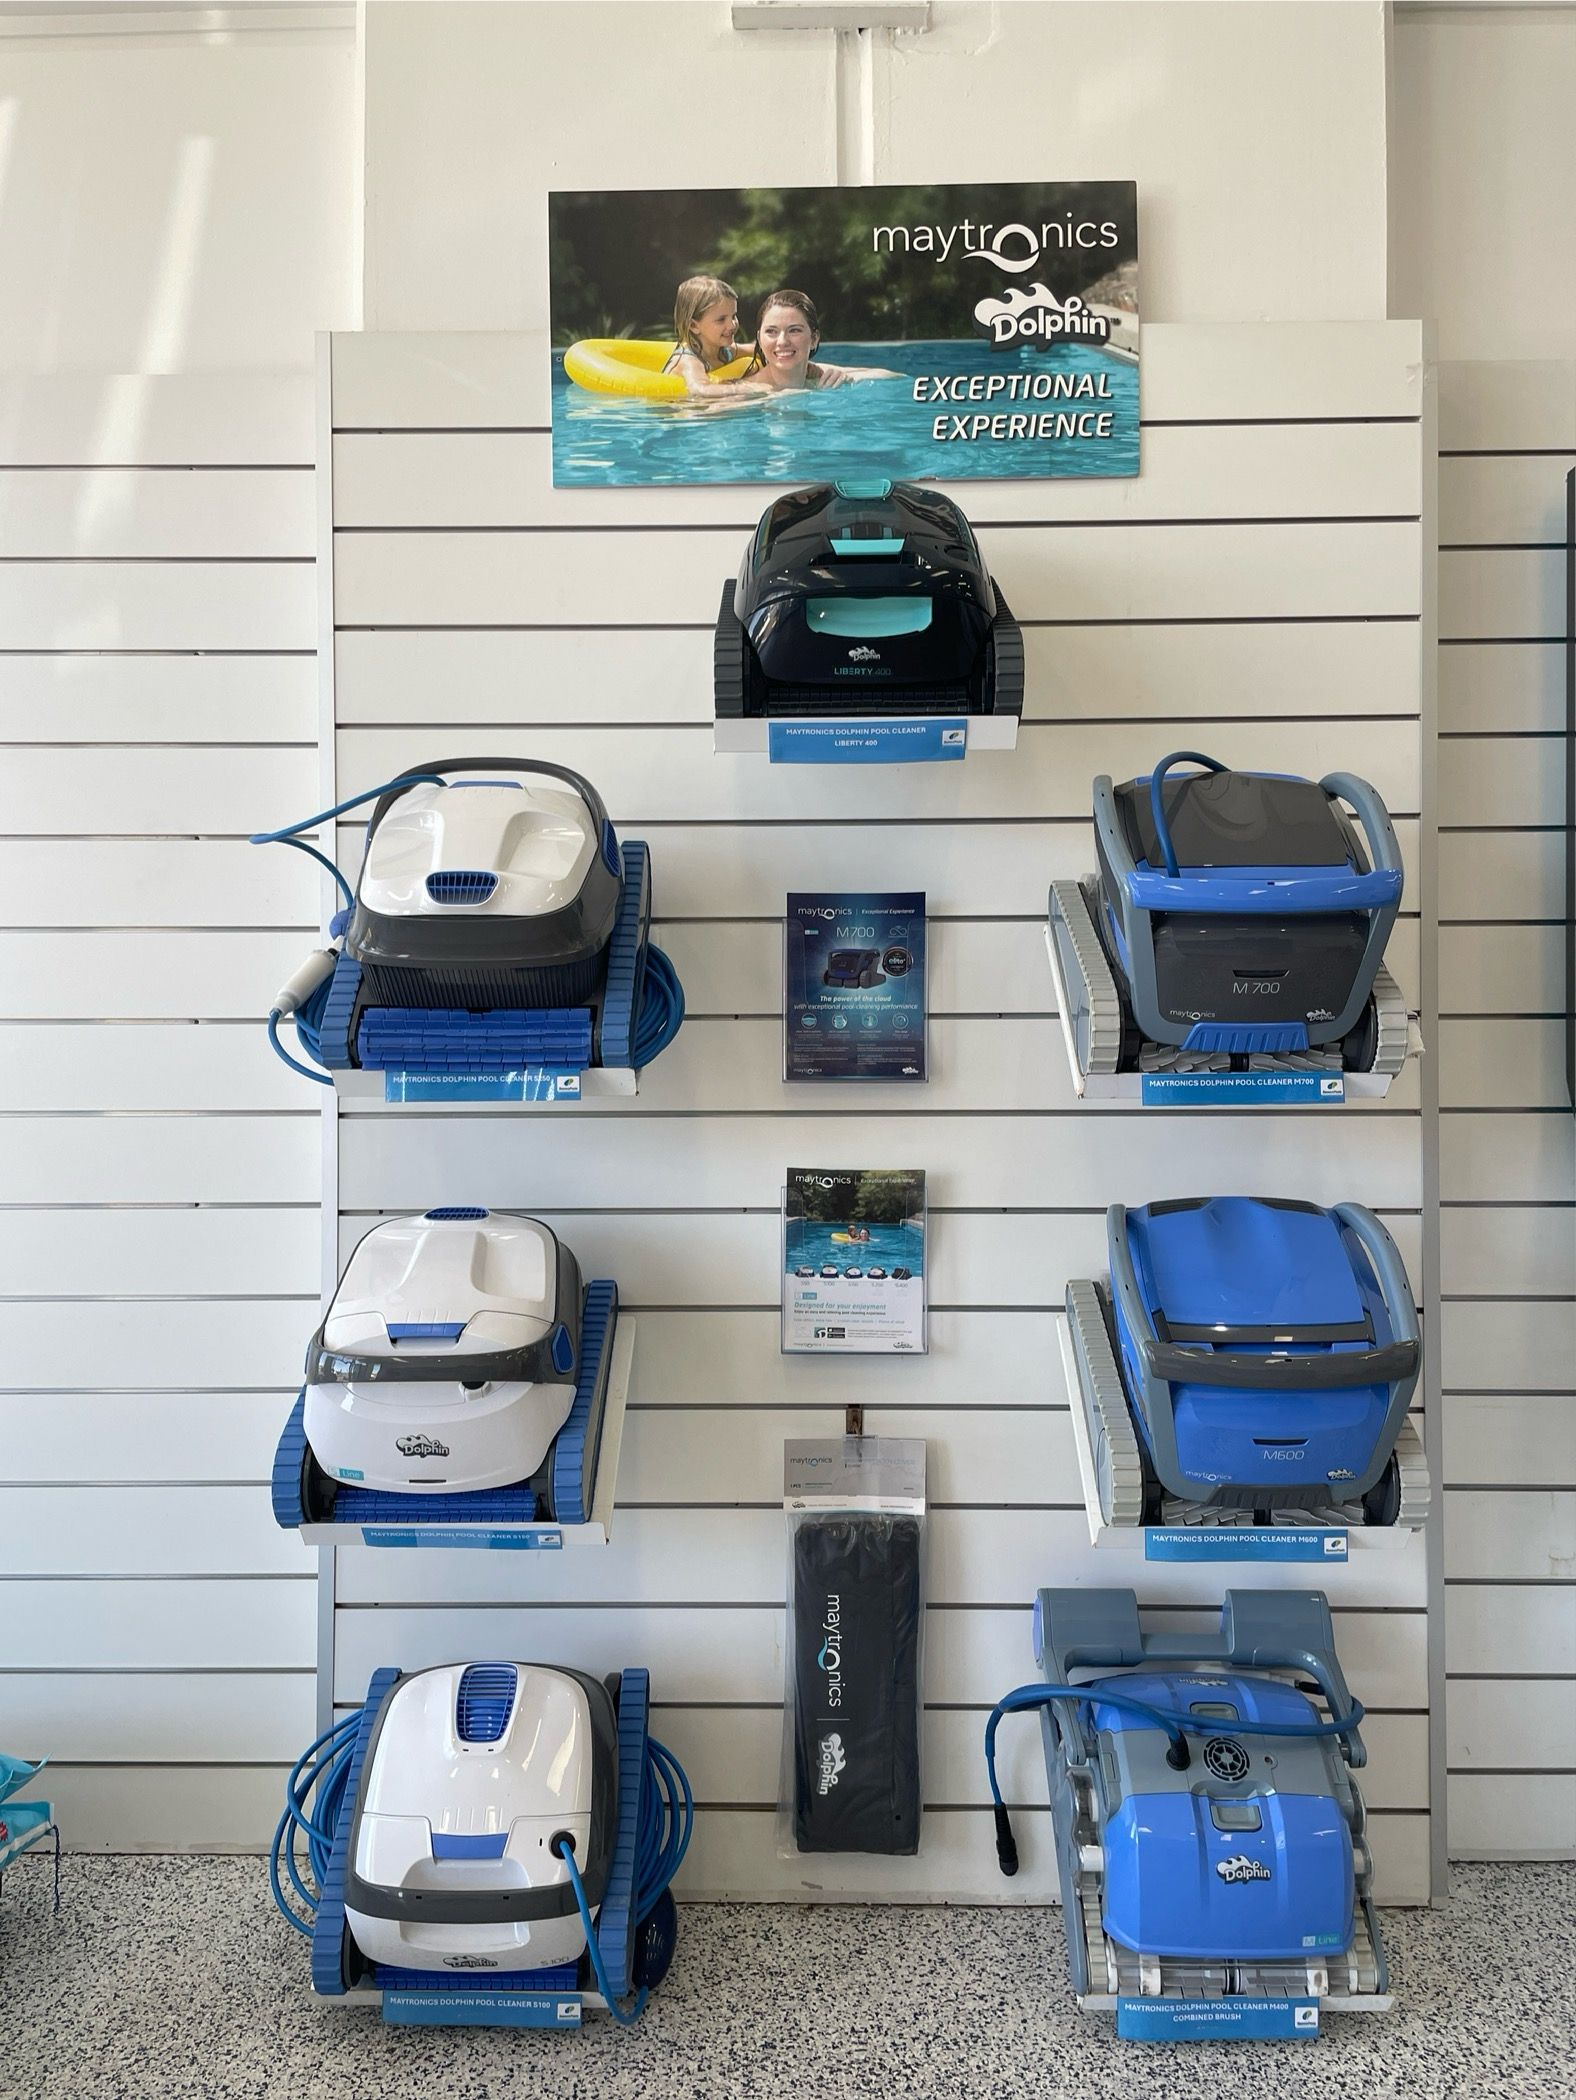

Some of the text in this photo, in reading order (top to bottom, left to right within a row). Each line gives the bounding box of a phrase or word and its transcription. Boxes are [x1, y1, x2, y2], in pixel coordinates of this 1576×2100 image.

[873, 212, 1119, 273] maytronics
[986, 293, 1107, 343] Dolphin
[912, 373, 1113, 401] EXCEPTIONAL
[932, 412, 1114, 440] EXPERIENCE
[852, 648, 881, 661] Dolphin
[834, 667, 873, 675] LIBERTY
[797, 907, 852, 920] maytronics
[808, 1003, 840, 1011] exceptional
[841, 1003, 855, 1011] pool
[856, 1003, 880, 1011] cleaning
[1169, 1009, 1216, 1021] maytronics
[1308, 1010, 1336, 1022] Dolphin
[393, 1075, 441, 1083] MAYTRONICS
[1149, 1079, 1199, 1087] MAYTRONICS
[1257, 1078, 1293, 1086] CLEANER
[795, 1174, 851, 1188] maytronics
[794, 1301, 824, 1310] Designed
[852, 1303, 886, 1311] enjoyment
[402, 1438, 450, 1456] Dolphin
[1263, 1449, 1305, 1461] M600
[1185, 1469, 1232, 1482] maytronics
[1152, 1534, 1203, 1543] MAYTRONICS
[1261, 1535, 1297, 1543] CLEANER
[1298, 1535, 1318, 1543] M600
[816, 1594, 846, 1707] maytronics
[818, 1737, 841, 1796] Dolphin
[1221, 1859, 1271, 1883] Dolphin
[451, 1956, 499, 1968] Dolphin
[390, 1997, 551, 2009] MAYTRONICS DOLPHIN POOL CLEANER S100
[1124, 2003, 1174, 2012] MAYTRONICS
[1175, 2003, 1209, 2012] DOLPHIN
[1173, 2013, 1241, 2023] COMBINED BRUSH
